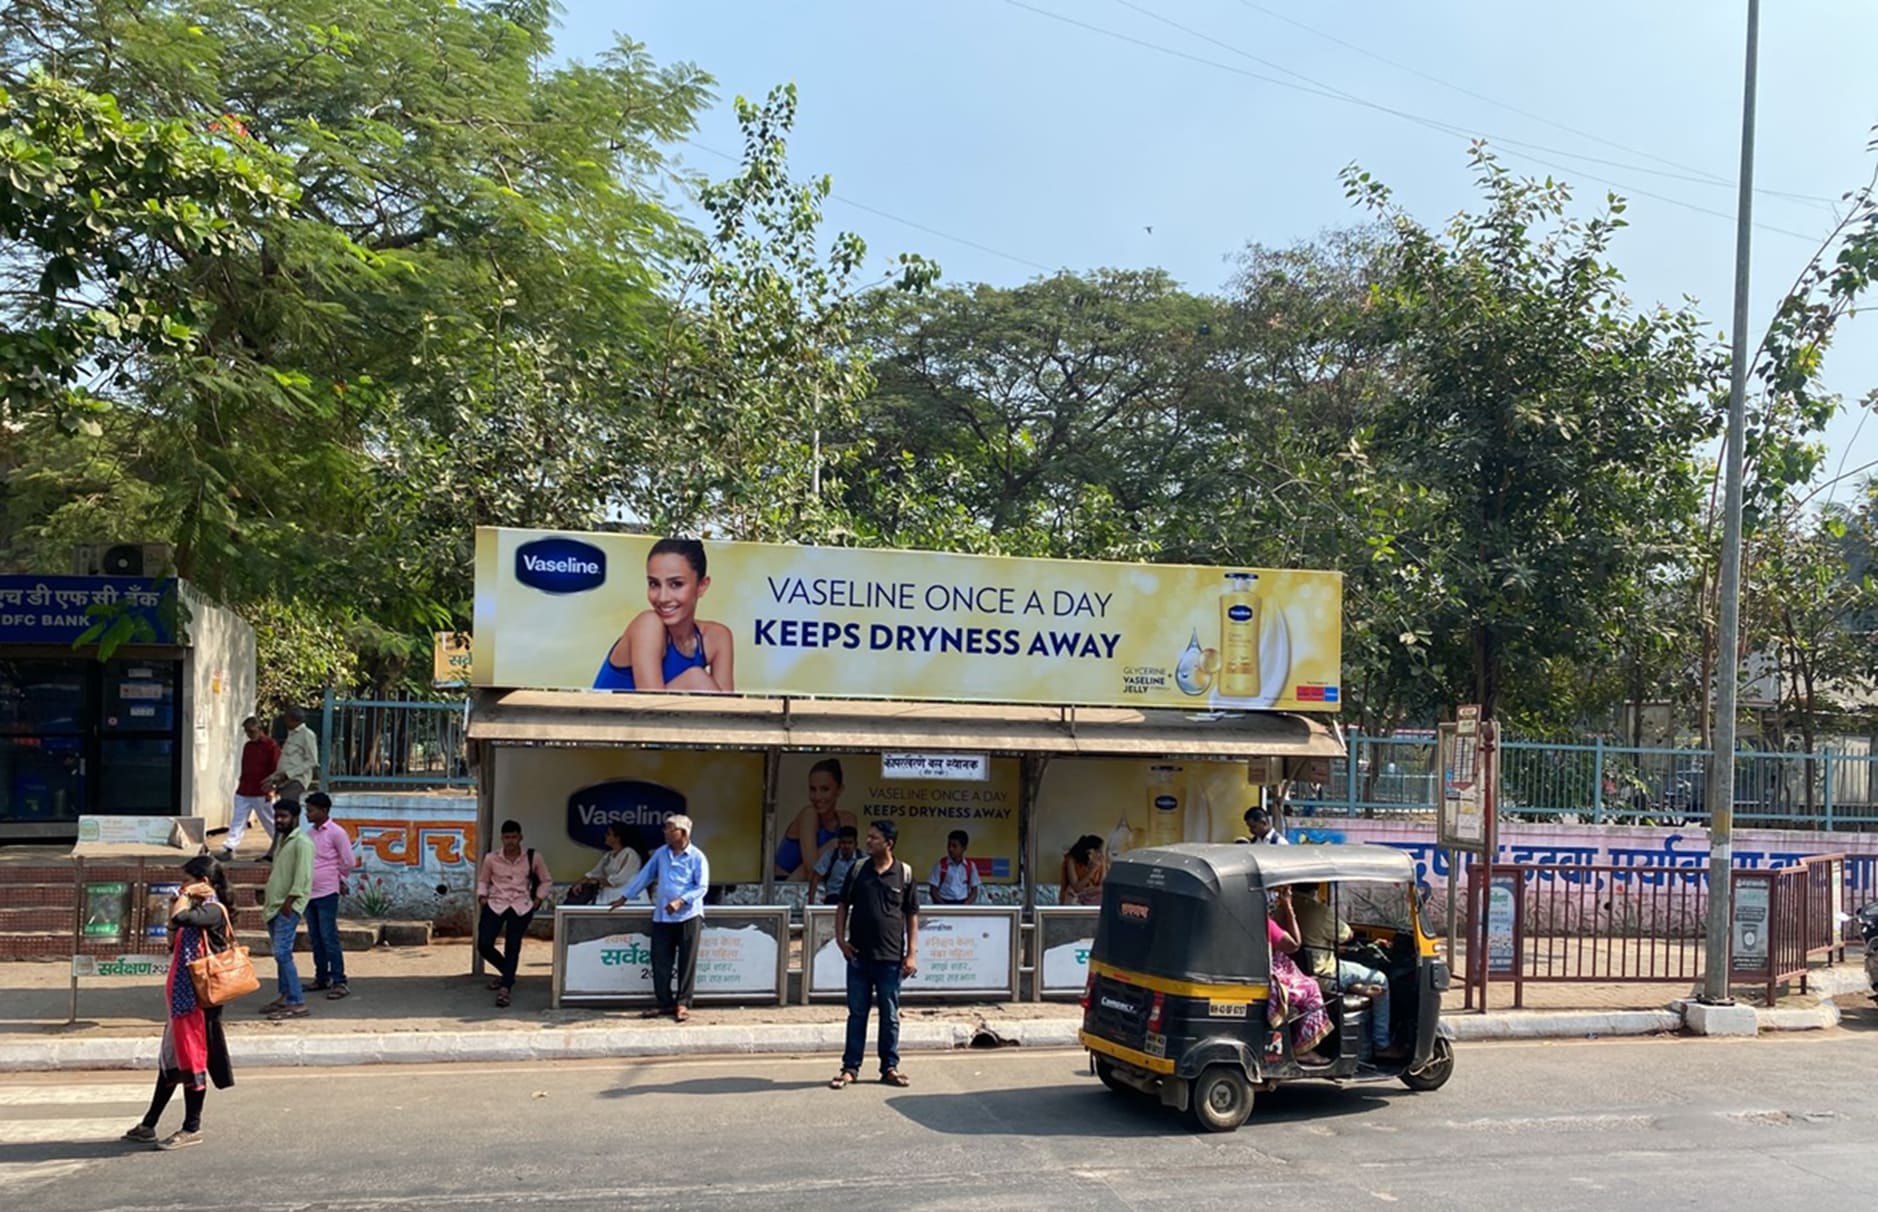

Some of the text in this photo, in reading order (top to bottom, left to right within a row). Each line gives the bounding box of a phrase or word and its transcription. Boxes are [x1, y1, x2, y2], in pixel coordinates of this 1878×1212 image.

[523, 554, 600, 575] Vaseline
[27, 583, 52, 606] डी
[55, 589, 89, 609] एफ
[767, 576, 1114, 618] VASELINE ONCE A DAY
[2, 614, 91, 627] DFC BANK
[754, 618, 1122, 659] KEEPS DRYNESS AWAY
[1123, 676, 1165, 685] VASELINE
[1123, 685, 1148, 693] JELLY
[869, 787, 1008, 802] VASELINE ONCE A DAY
[863, 804, 1012, 819] KEEPS DRYNESS AWAY
